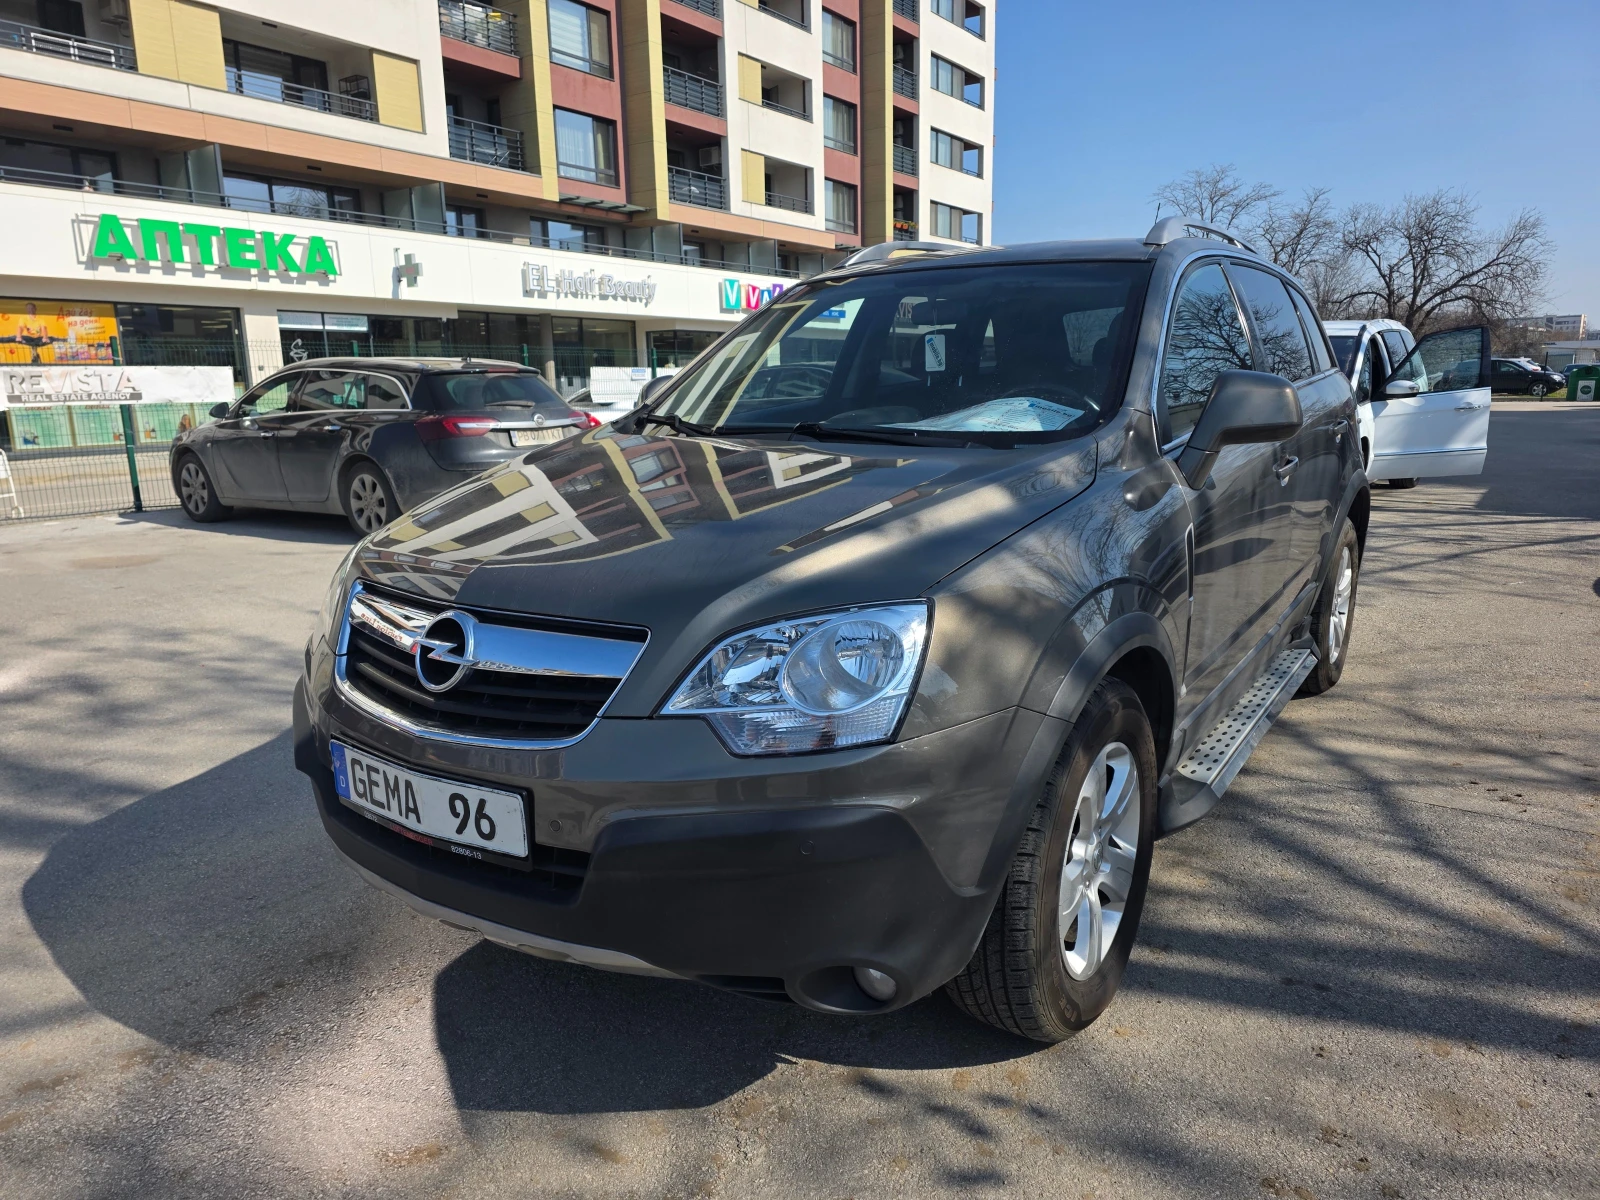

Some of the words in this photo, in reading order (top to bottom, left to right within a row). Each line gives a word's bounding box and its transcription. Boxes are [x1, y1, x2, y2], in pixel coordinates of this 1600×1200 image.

[93, 213, 338, 276] АПТЕКА
[527, 263, 555, 292] EL
[561, 268, 597, 295] Hair
[603, 273, 657, 304] Beauty
[3, 370, 141, 394] REVISTA
[21, 394, 49, 402] REAL
[52, 393, 88, 401] ESTATE
[91, 392, 131, 400] AGENCY
[340, 775, 346, 788] D
[350, 757, 422, 825] GEMA
[449, 792, 496, 841] 96
